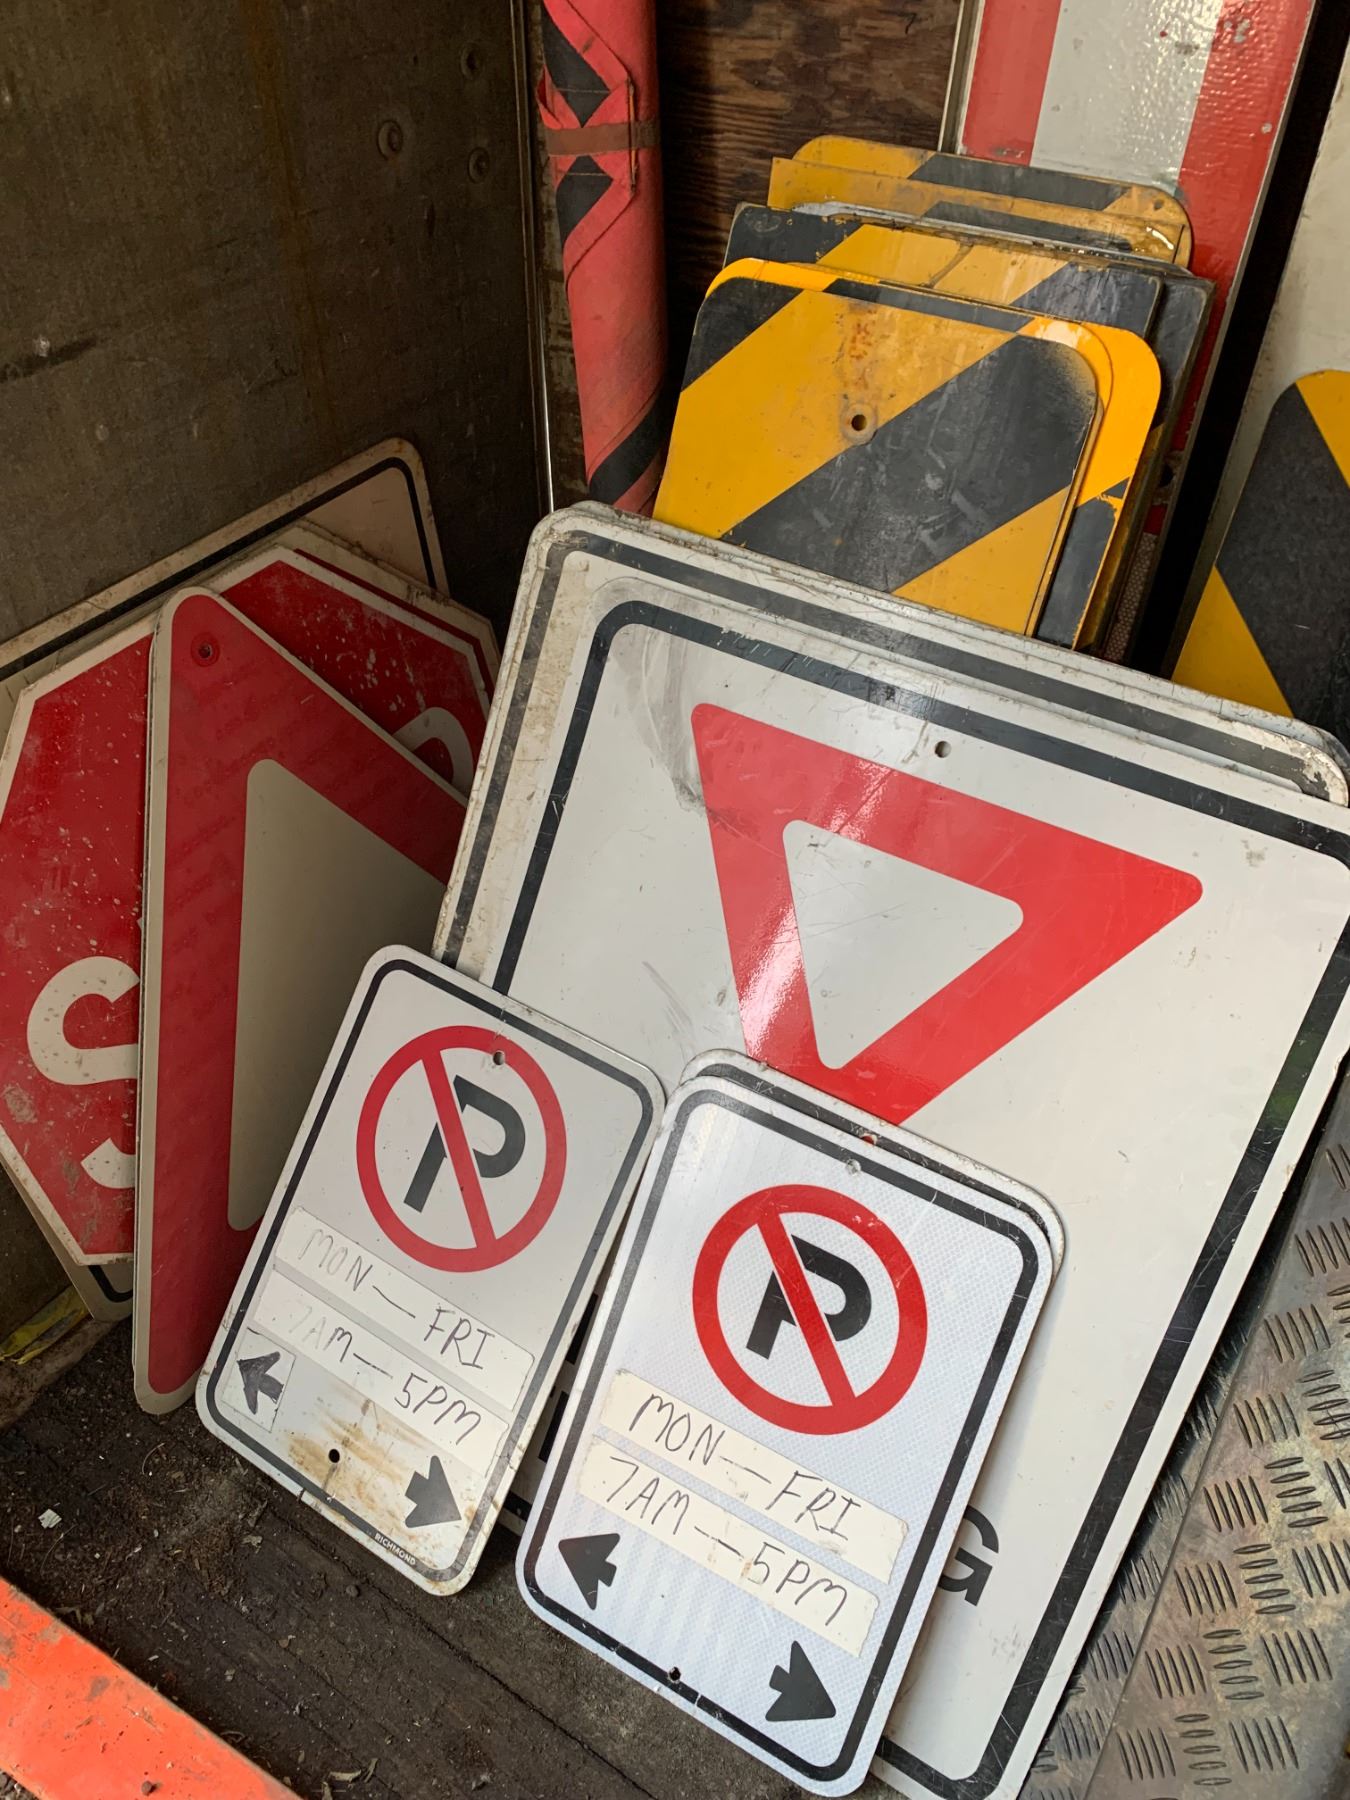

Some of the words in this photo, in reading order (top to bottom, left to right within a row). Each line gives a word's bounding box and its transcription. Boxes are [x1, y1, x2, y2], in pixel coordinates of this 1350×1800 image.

[394, 1373, 481, 1445] 5PM
[374, 1532, 416, 1566] RICHMOND
[747, 1541, 848, 1626] 5PM
